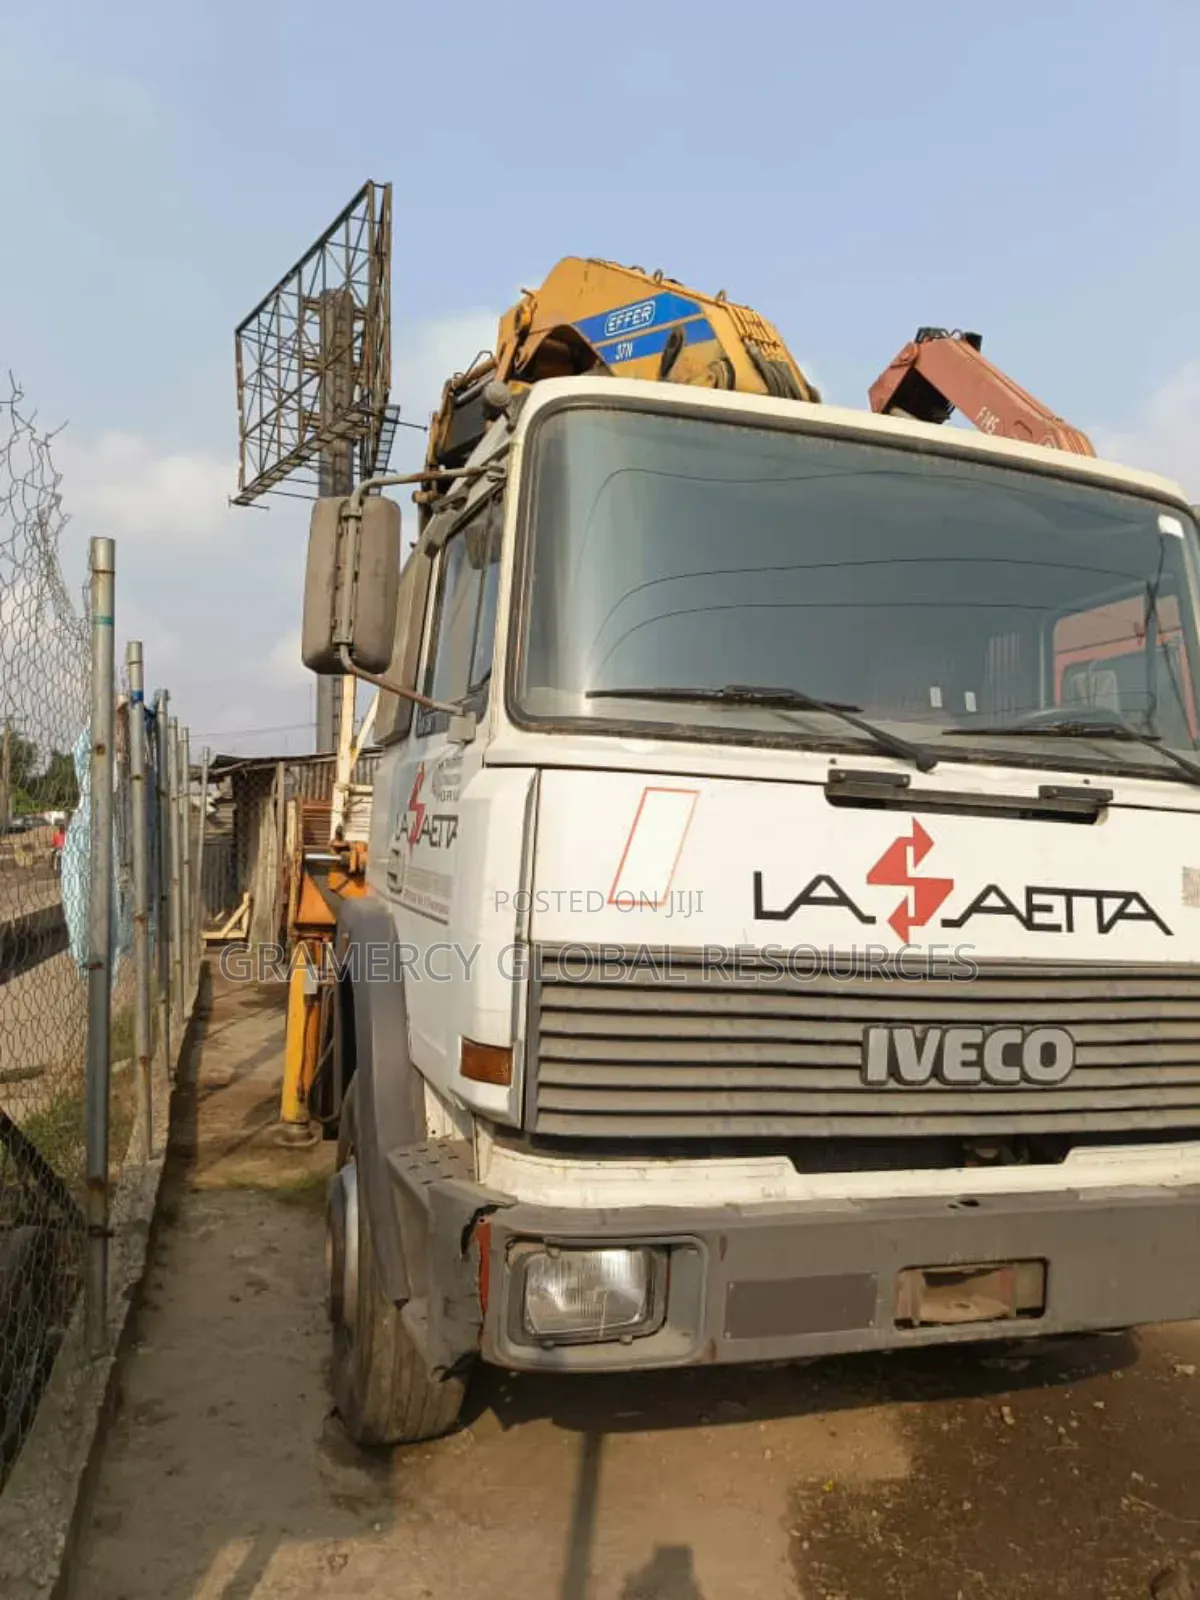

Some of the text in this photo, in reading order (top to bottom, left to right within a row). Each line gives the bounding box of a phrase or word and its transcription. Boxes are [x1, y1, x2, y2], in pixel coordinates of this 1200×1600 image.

[607, 305, 653, 332] EFFER
[753, 871, 876, 924] LA
[865, 1027, 1075, 1084] IVECO
